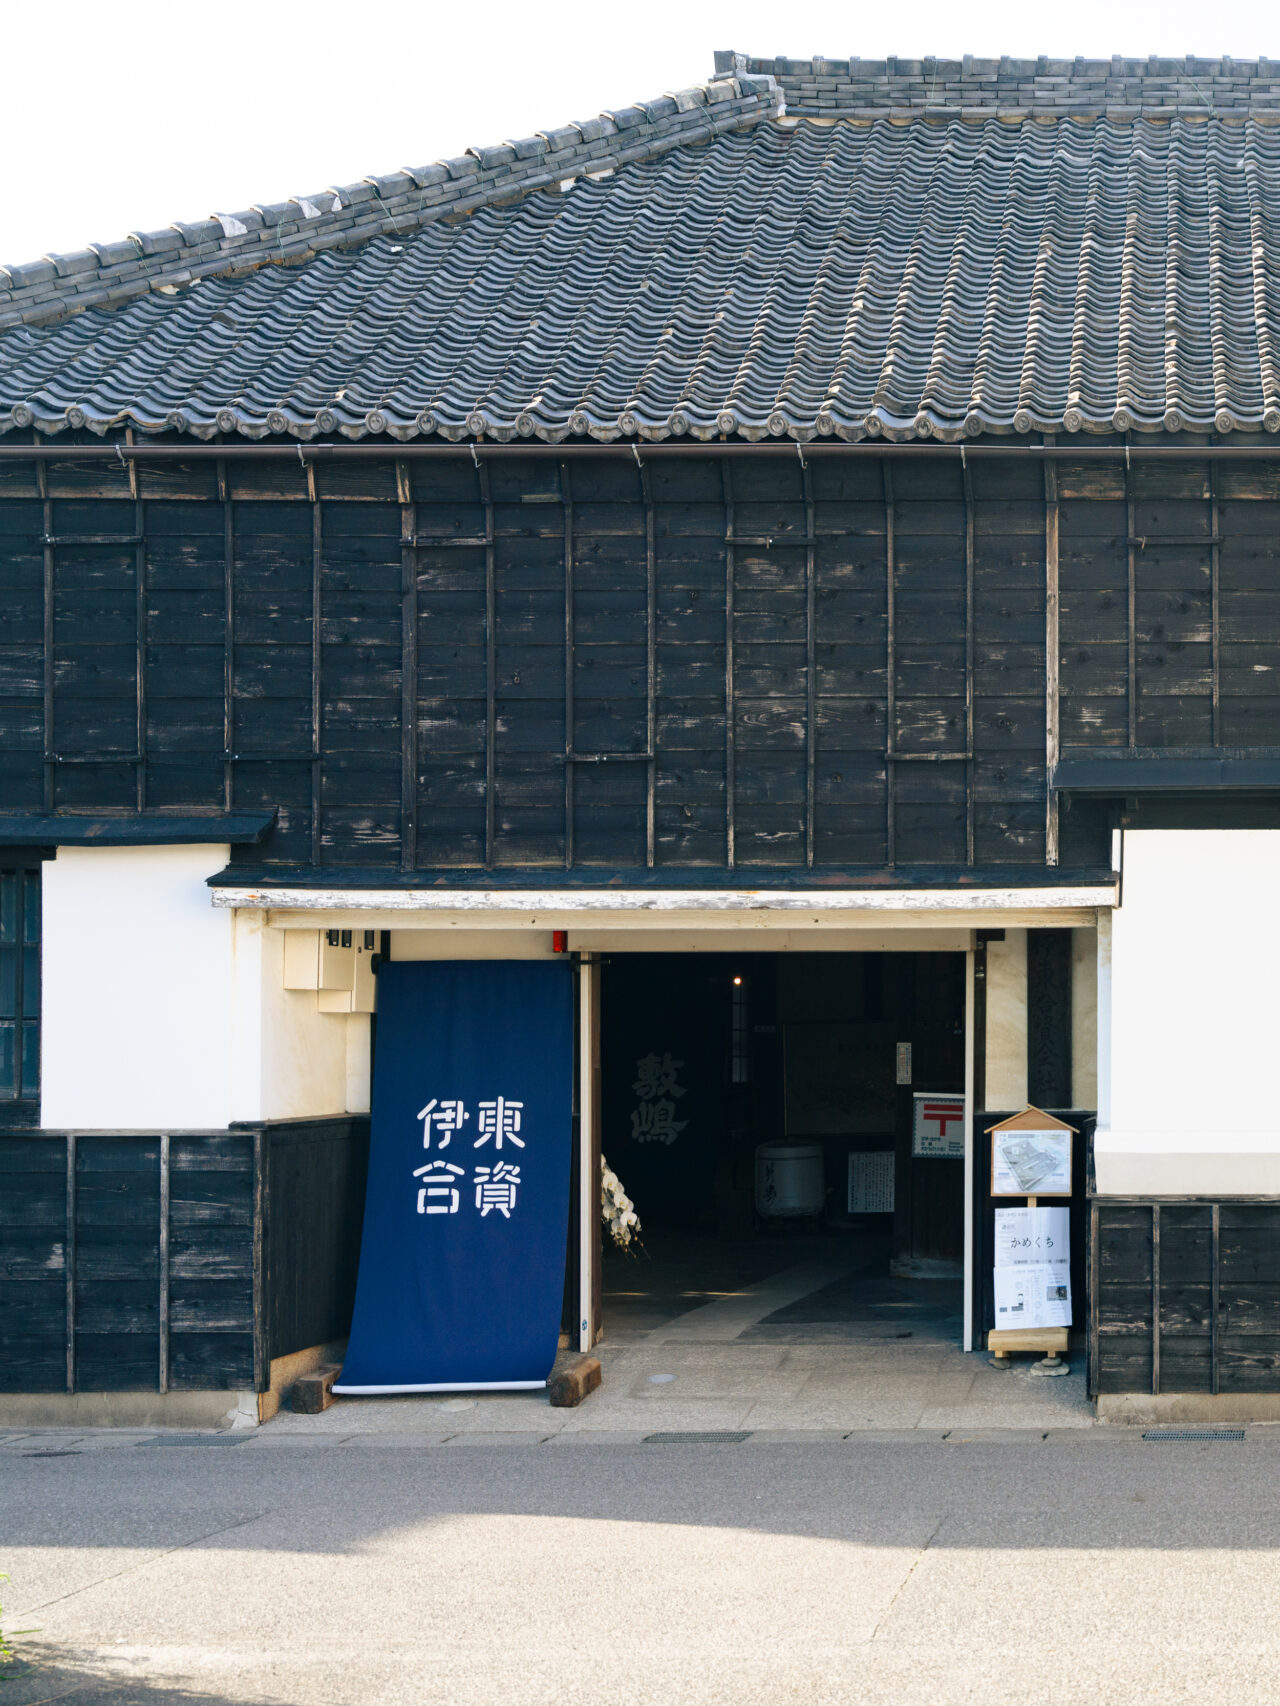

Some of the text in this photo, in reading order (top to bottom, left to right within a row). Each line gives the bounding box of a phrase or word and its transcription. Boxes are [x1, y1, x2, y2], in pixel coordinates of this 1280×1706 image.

[416, 1095, 526, 1151] 伊東
[630, 1050, 690, 1146] 敷嶋
[412, 1160, 522, 1220] 合資
[1010, 1235, 1055, 1249] かめくち
